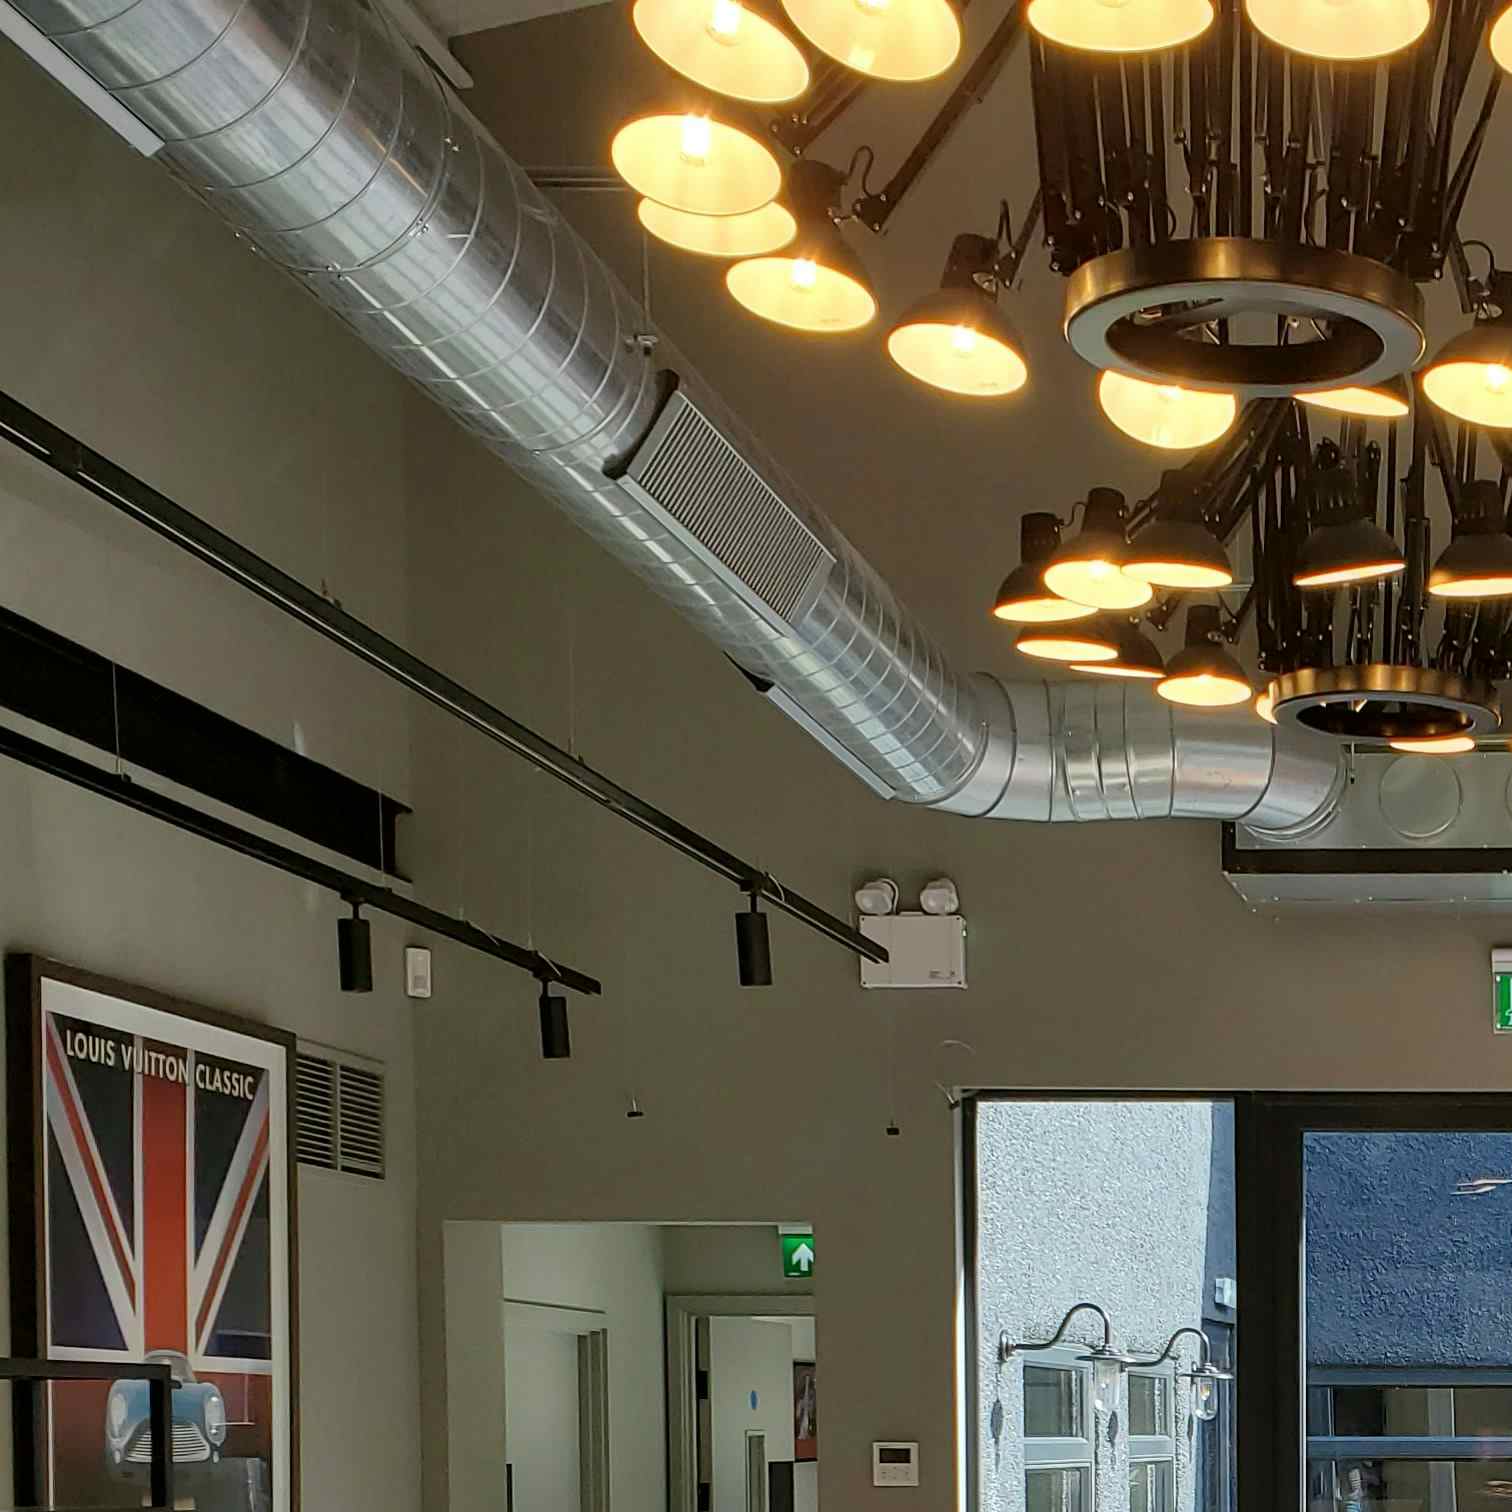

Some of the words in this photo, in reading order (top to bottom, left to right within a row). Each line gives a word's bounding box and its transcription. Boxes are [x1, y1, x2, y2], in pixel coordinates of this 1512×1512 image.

[65, 1029, 116, 1067] LOUIS
[121, 1043, 190, 1085] VUITTON
[195, 1062, 255, 1100] CLASSIC
